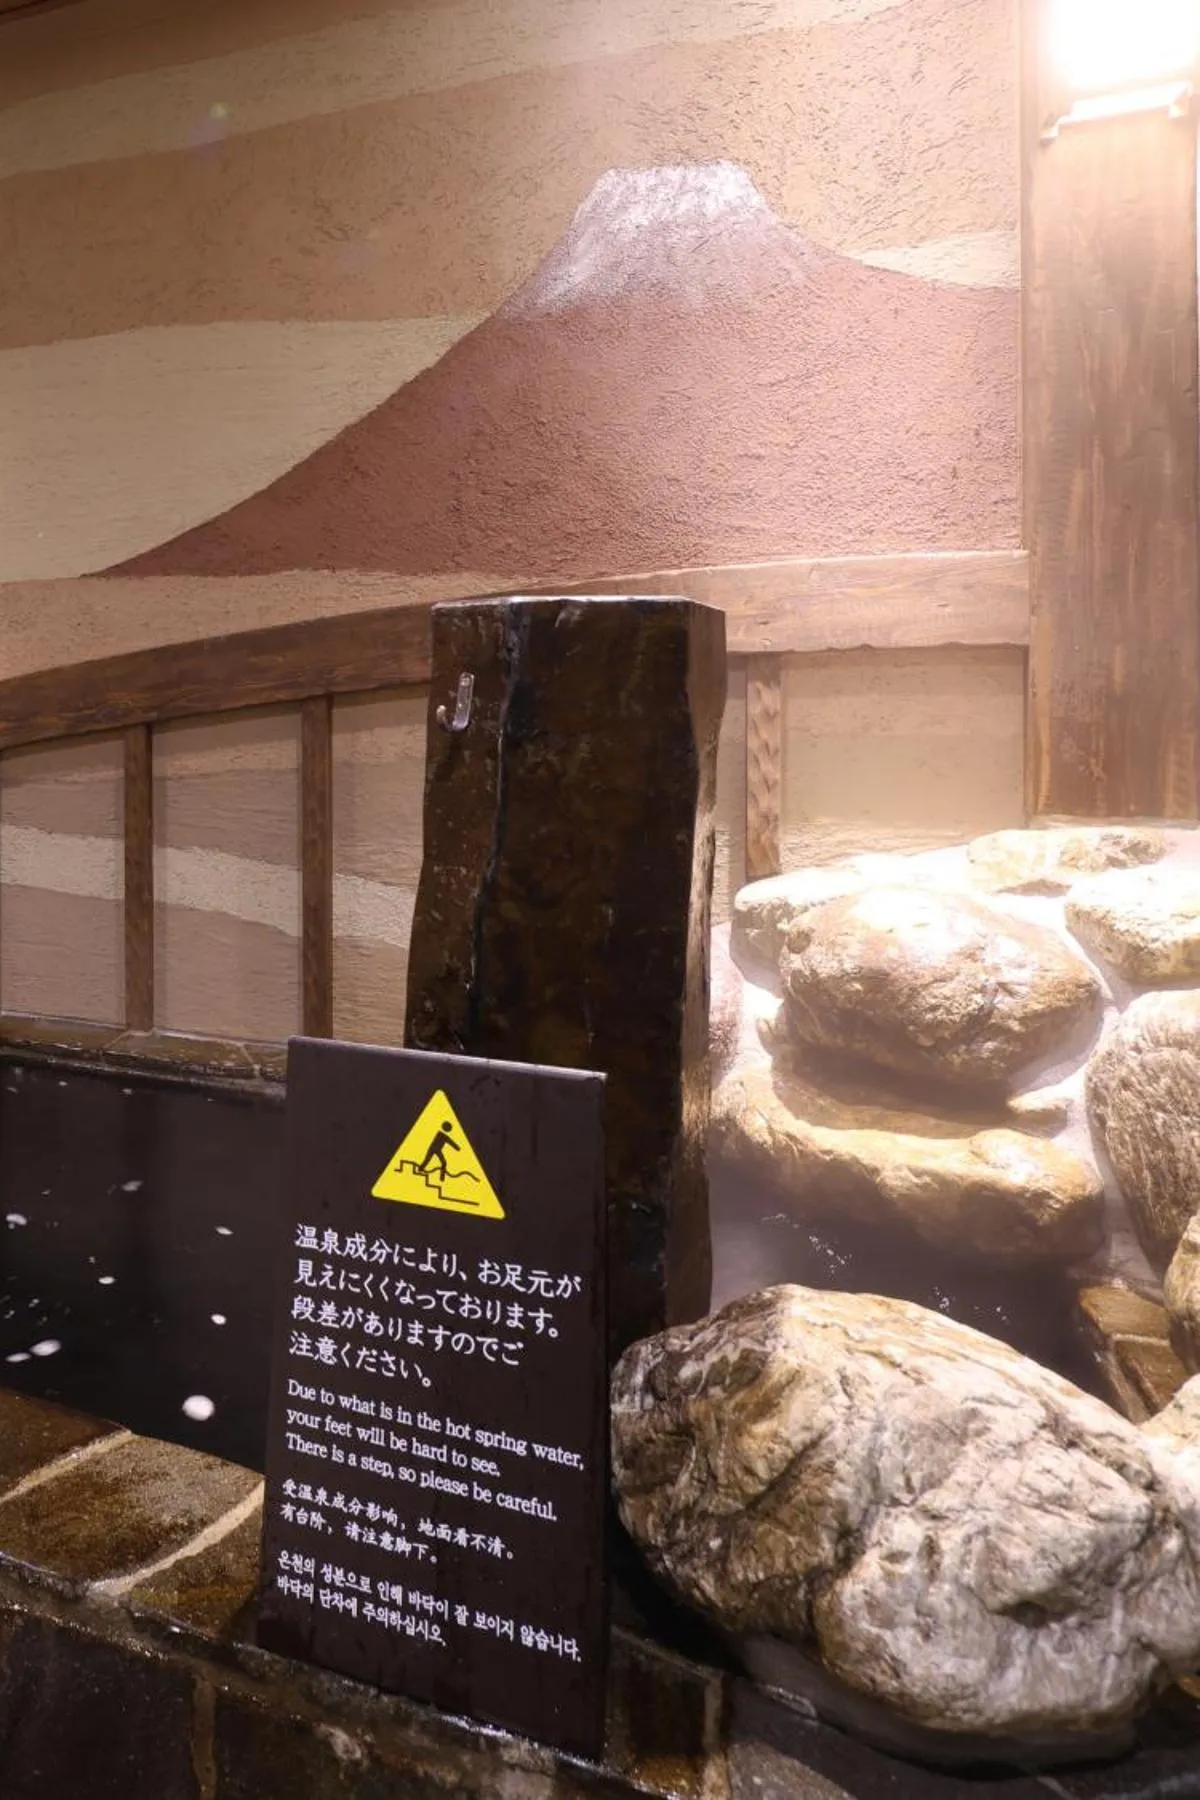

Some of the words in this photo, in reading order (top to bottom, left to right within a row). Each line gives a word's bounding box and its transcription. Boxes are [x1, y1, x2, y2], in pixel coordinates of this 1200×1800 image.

[295, 1223, 581, 1298] 温泉成分により、お足元が
[290, 1295, 524, 1366] 段差がありますのでご
[293, 1259, 559, 1338] 見えにくくなっております。
[288, 1331, 432, 1388] 注意ください。
[286, 1408, 321, 1429] your
[324, 1414, 352, 1438] feet
[356, 1426, 386, 1447] will
[389, 1431, 408, 1452] be
[411, 1437, 447, 1463] hard
[451, 1449, 467, 1467] to
[471, 1456, 500, 1477] see.
[288, 1379, 316, 1400] Due
[320, 1387, 335, 1405] to
[339, 1394, 376, 1416] what
[379, 1401, 393, 1421] is
[396, 1405, 413, 1426] in
[417, 1411, 442, 1432] the
[445, 1417, 471, 1440] hot
[475, 1428, 527, 1456] spring
[532, 1442, 584, 1471] water,
[285, 1431, 328, 1458] There
[331, 1443, 344, 1463] is
[348, 1453, 357, 1466] a
[361, 1455, 395, 1479] step,
[399, 1466, 417, 1482] so
[420, 1469, 469, 1497] please
[472, 1481, 492, 1503] be
[496, 1491, 557, 1521] careful.
[277, 1574, 315, 1604] 바닥의
[277, 1550, 316, 1578] 온천의
[320, 1563, 373, 1594] 성분으로
[377, 1581, 403, 1606] 인해
[408, 1590, 449, 1621] 바닥이
[473, 1611, 514, 1642] 보이지
